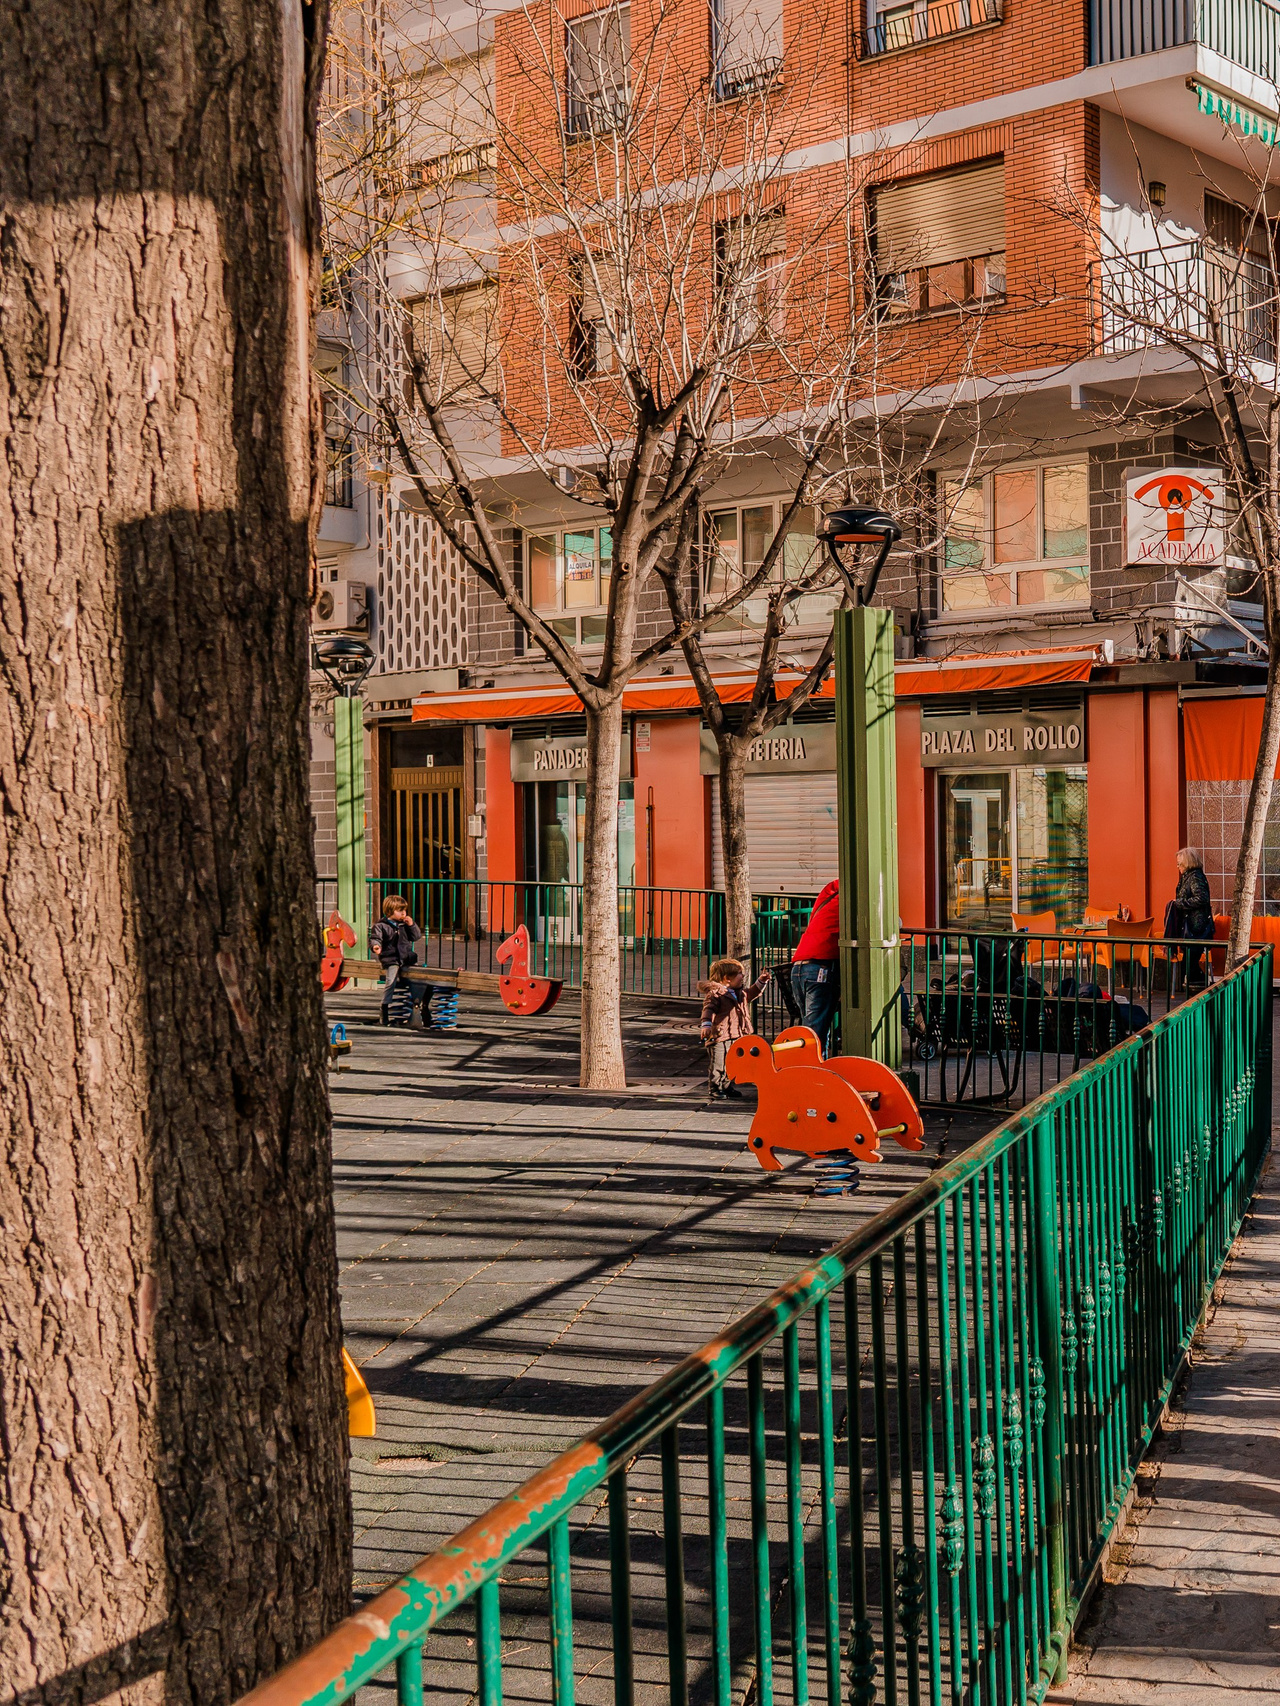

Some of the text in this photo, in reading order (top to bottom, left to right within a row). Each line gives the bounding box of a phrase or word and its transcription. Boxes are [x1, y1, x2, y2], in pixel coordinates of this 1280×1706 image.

[1137, 541, 1216, 560] ACADEMIA
[746, 737, 806, 761] FETERIA
[921, 725, 1081, 755] PLAZA DEL ROLLO
[534, 748, 588, 771] PANADER
